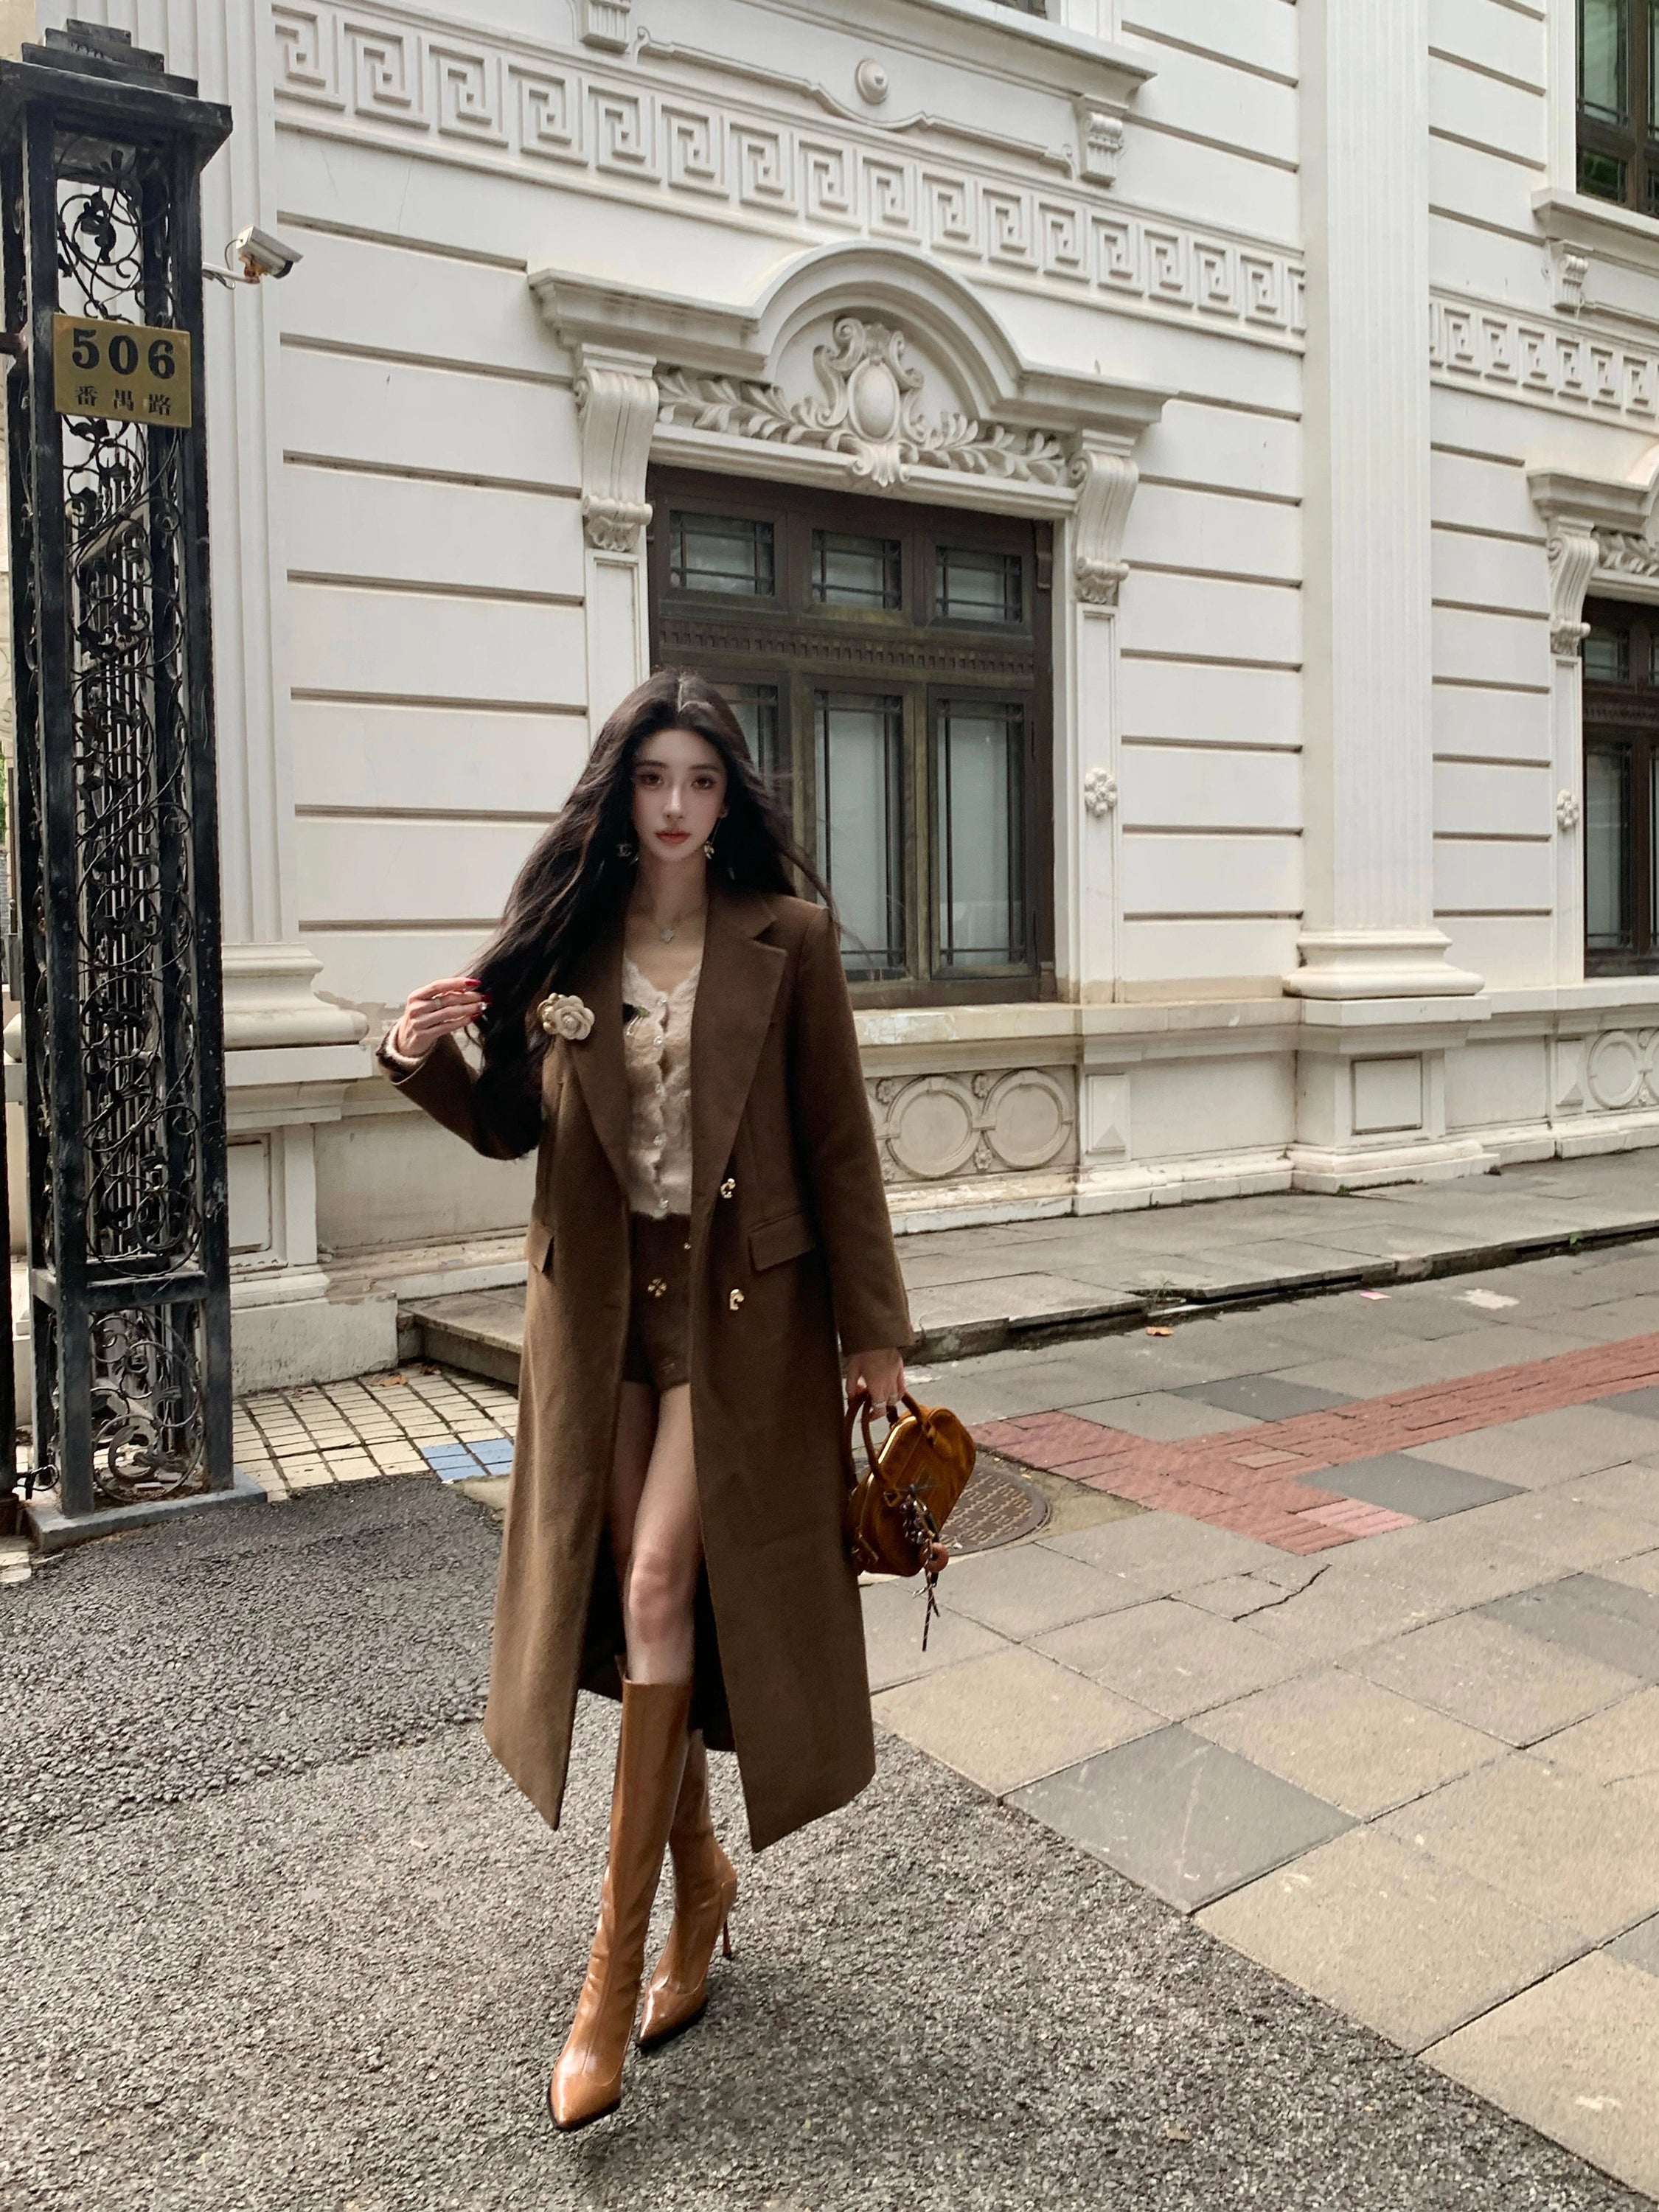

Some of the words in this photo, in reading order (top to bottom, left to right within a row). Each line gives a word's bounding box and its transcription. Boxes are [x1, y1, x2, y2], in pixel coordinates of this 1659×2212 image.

[72, 328, 175, 379] 506
[75, 386, 171, 415] 番禺路
